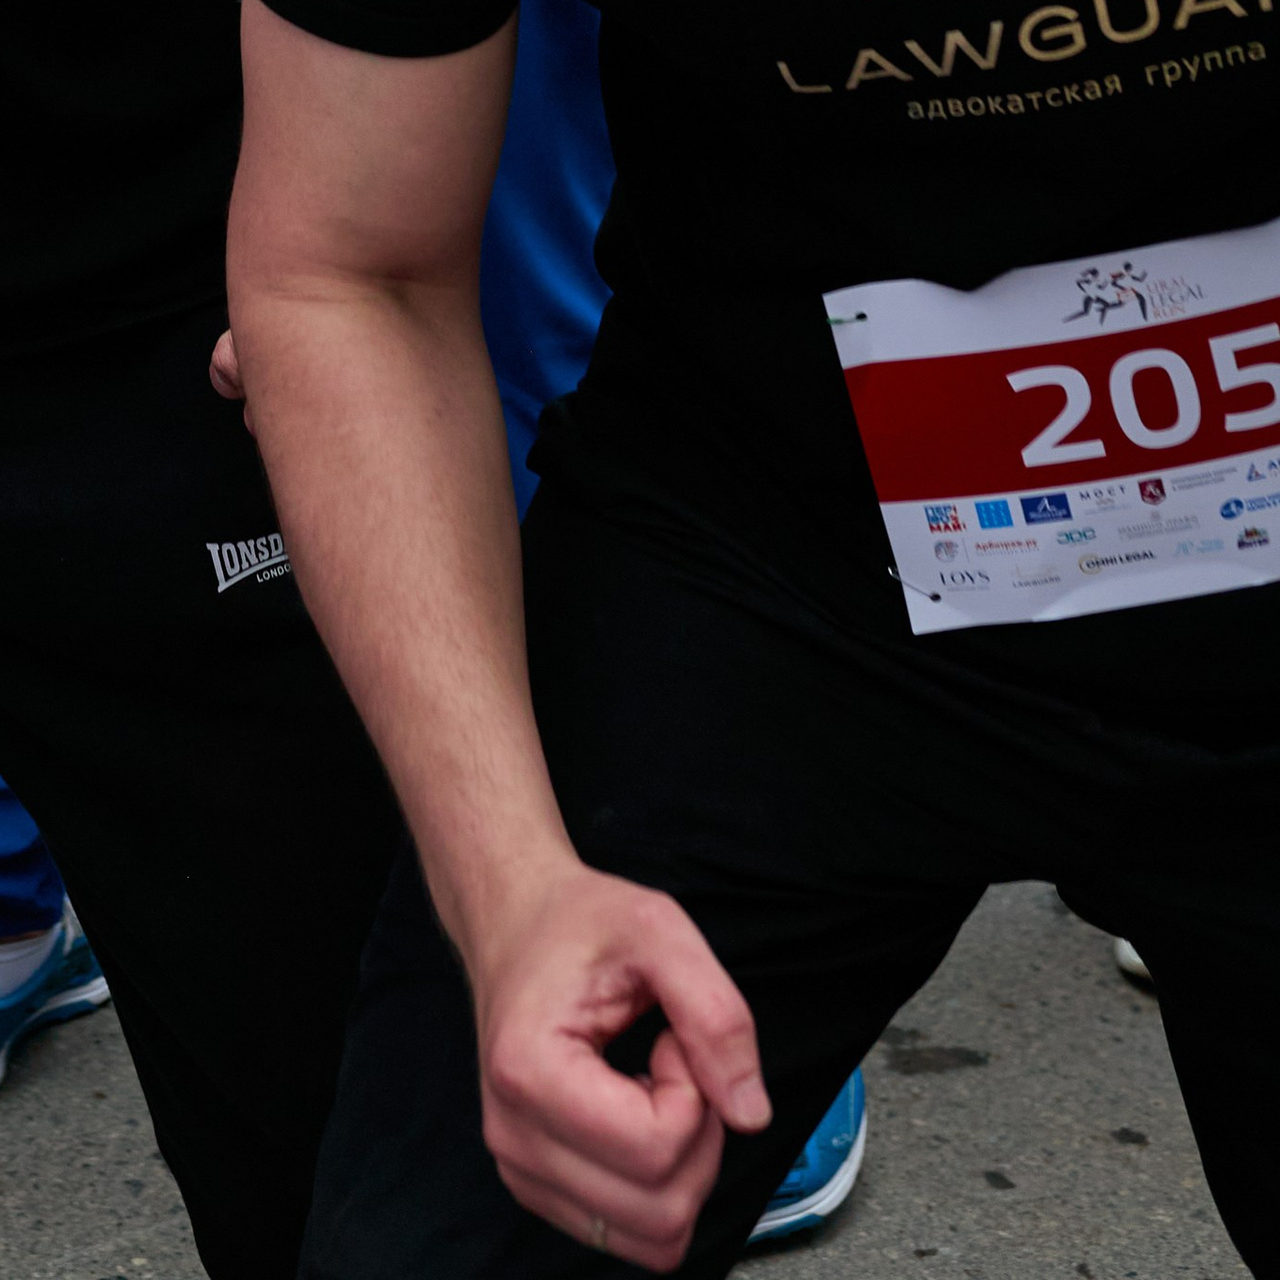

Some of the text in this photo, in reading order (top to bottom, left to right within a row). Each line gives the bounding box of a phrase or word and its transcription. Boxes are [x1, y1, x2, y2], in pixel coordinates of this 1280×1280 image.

[907, 39, 1267, 121] адвокатская группа
[1006, 322, 1280, 468] 205
